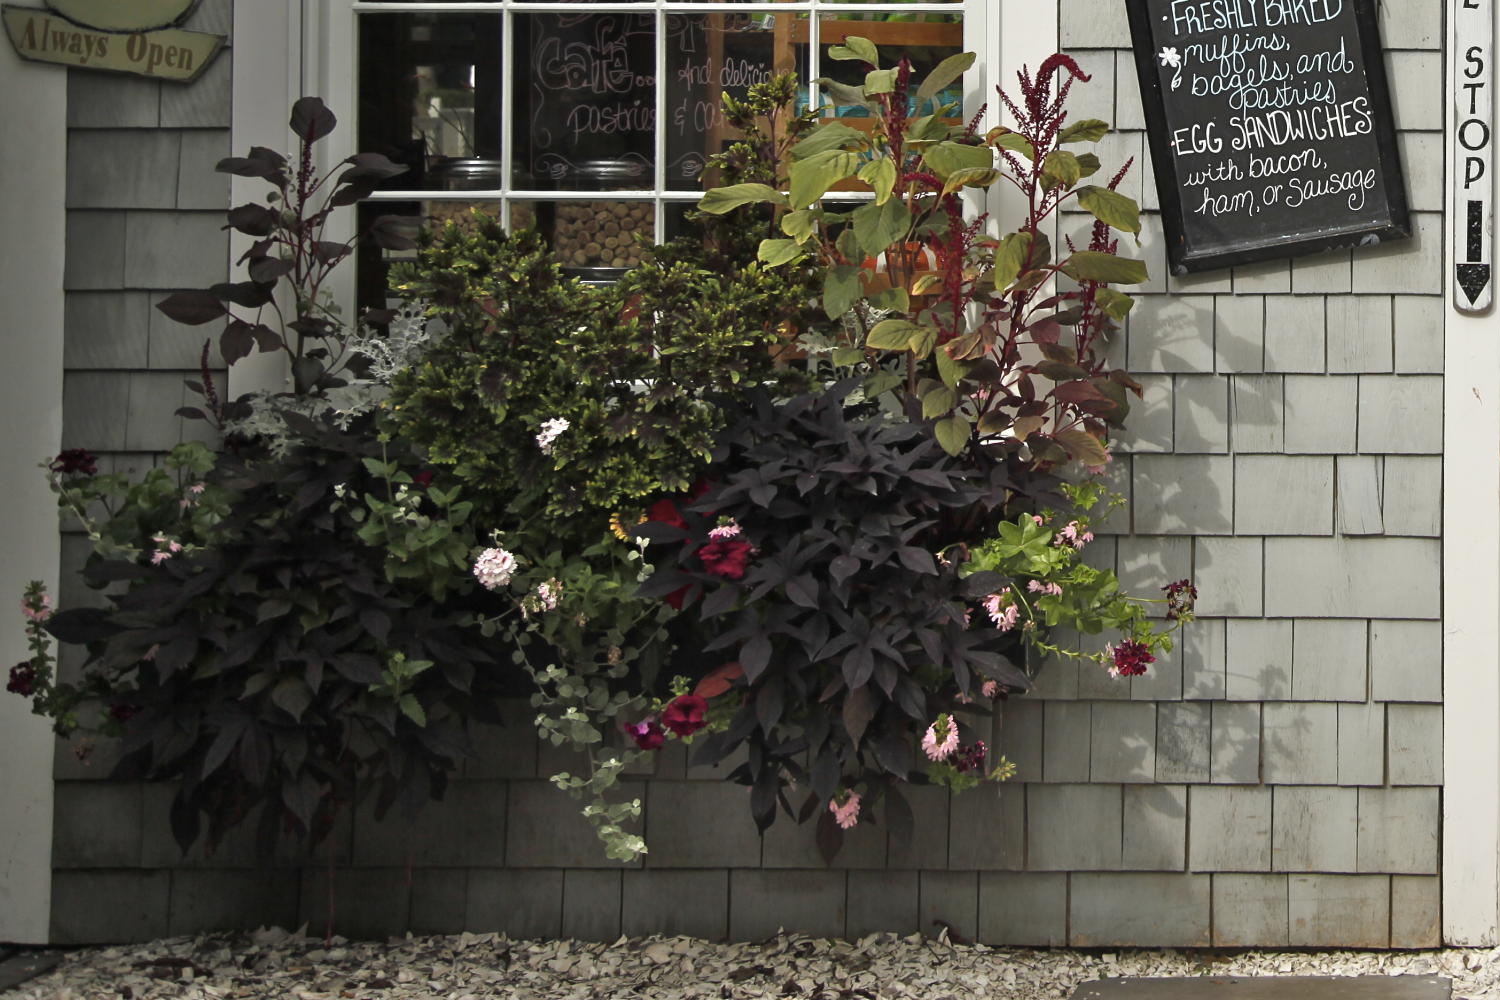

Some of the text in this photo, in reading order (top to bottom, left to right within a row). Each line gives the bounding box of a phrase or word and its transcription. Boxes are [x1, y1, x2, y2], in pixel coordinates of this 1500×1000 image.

[20, 16, 194, 74] Always Open
[1183, 31, 1291, 76] muffins,
[1191, 36, 1355, 110] bagels, and
[1240, 78, 1337, 121] pastries
[1458, 45, 1490, 190] STOP
[1174, 96, 1373, 157] EGG SANDWICHES
[1183, 147, 1328, 188] with bacon,
[1194, 187, 1260, 217] ham,
[1262, 183, 1285, 205] or
